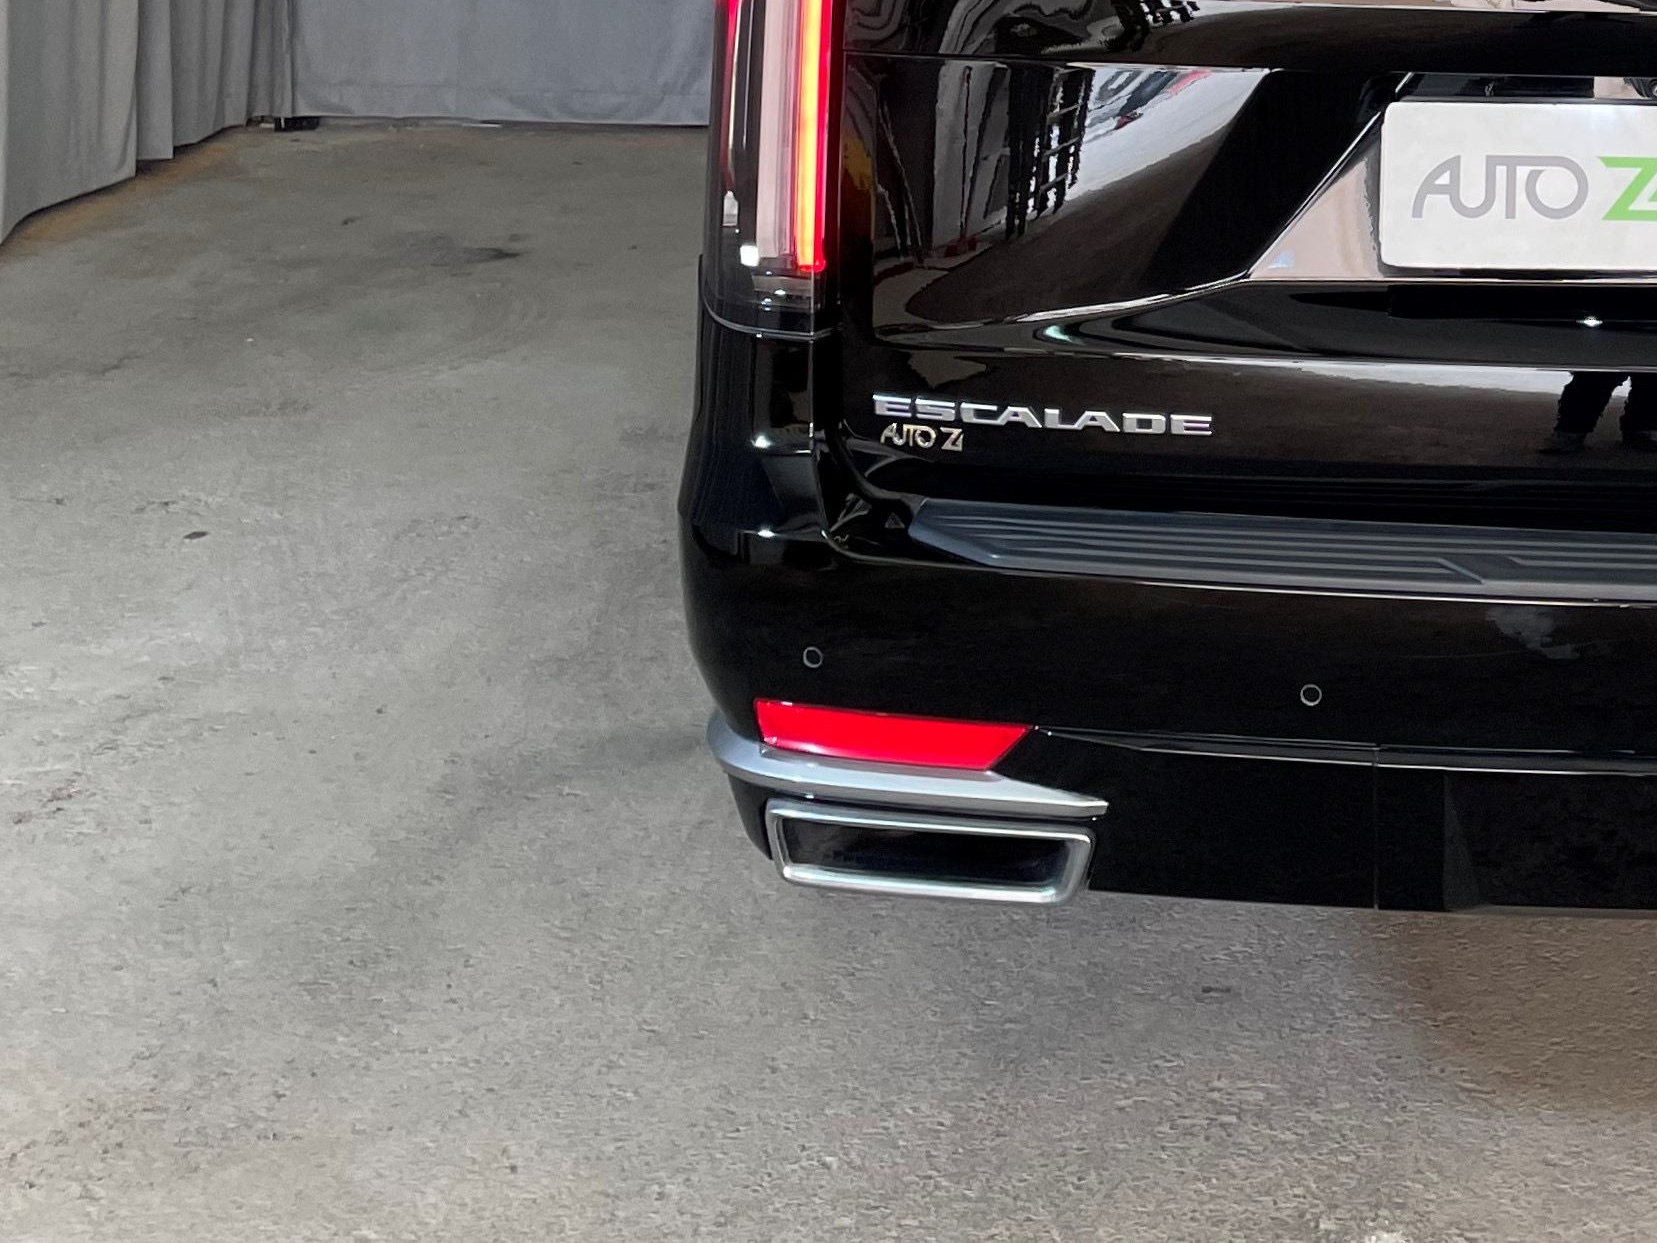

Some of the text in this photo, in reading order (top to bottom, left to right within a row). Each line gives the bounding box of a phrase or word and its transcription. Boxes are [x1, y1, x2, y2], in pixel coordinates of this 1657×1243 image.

[1411, 154, 1589, 220] AUTO
[873, 394, 1213, 435] ESCALADE
[880, 422, 936, 448] AUTO
